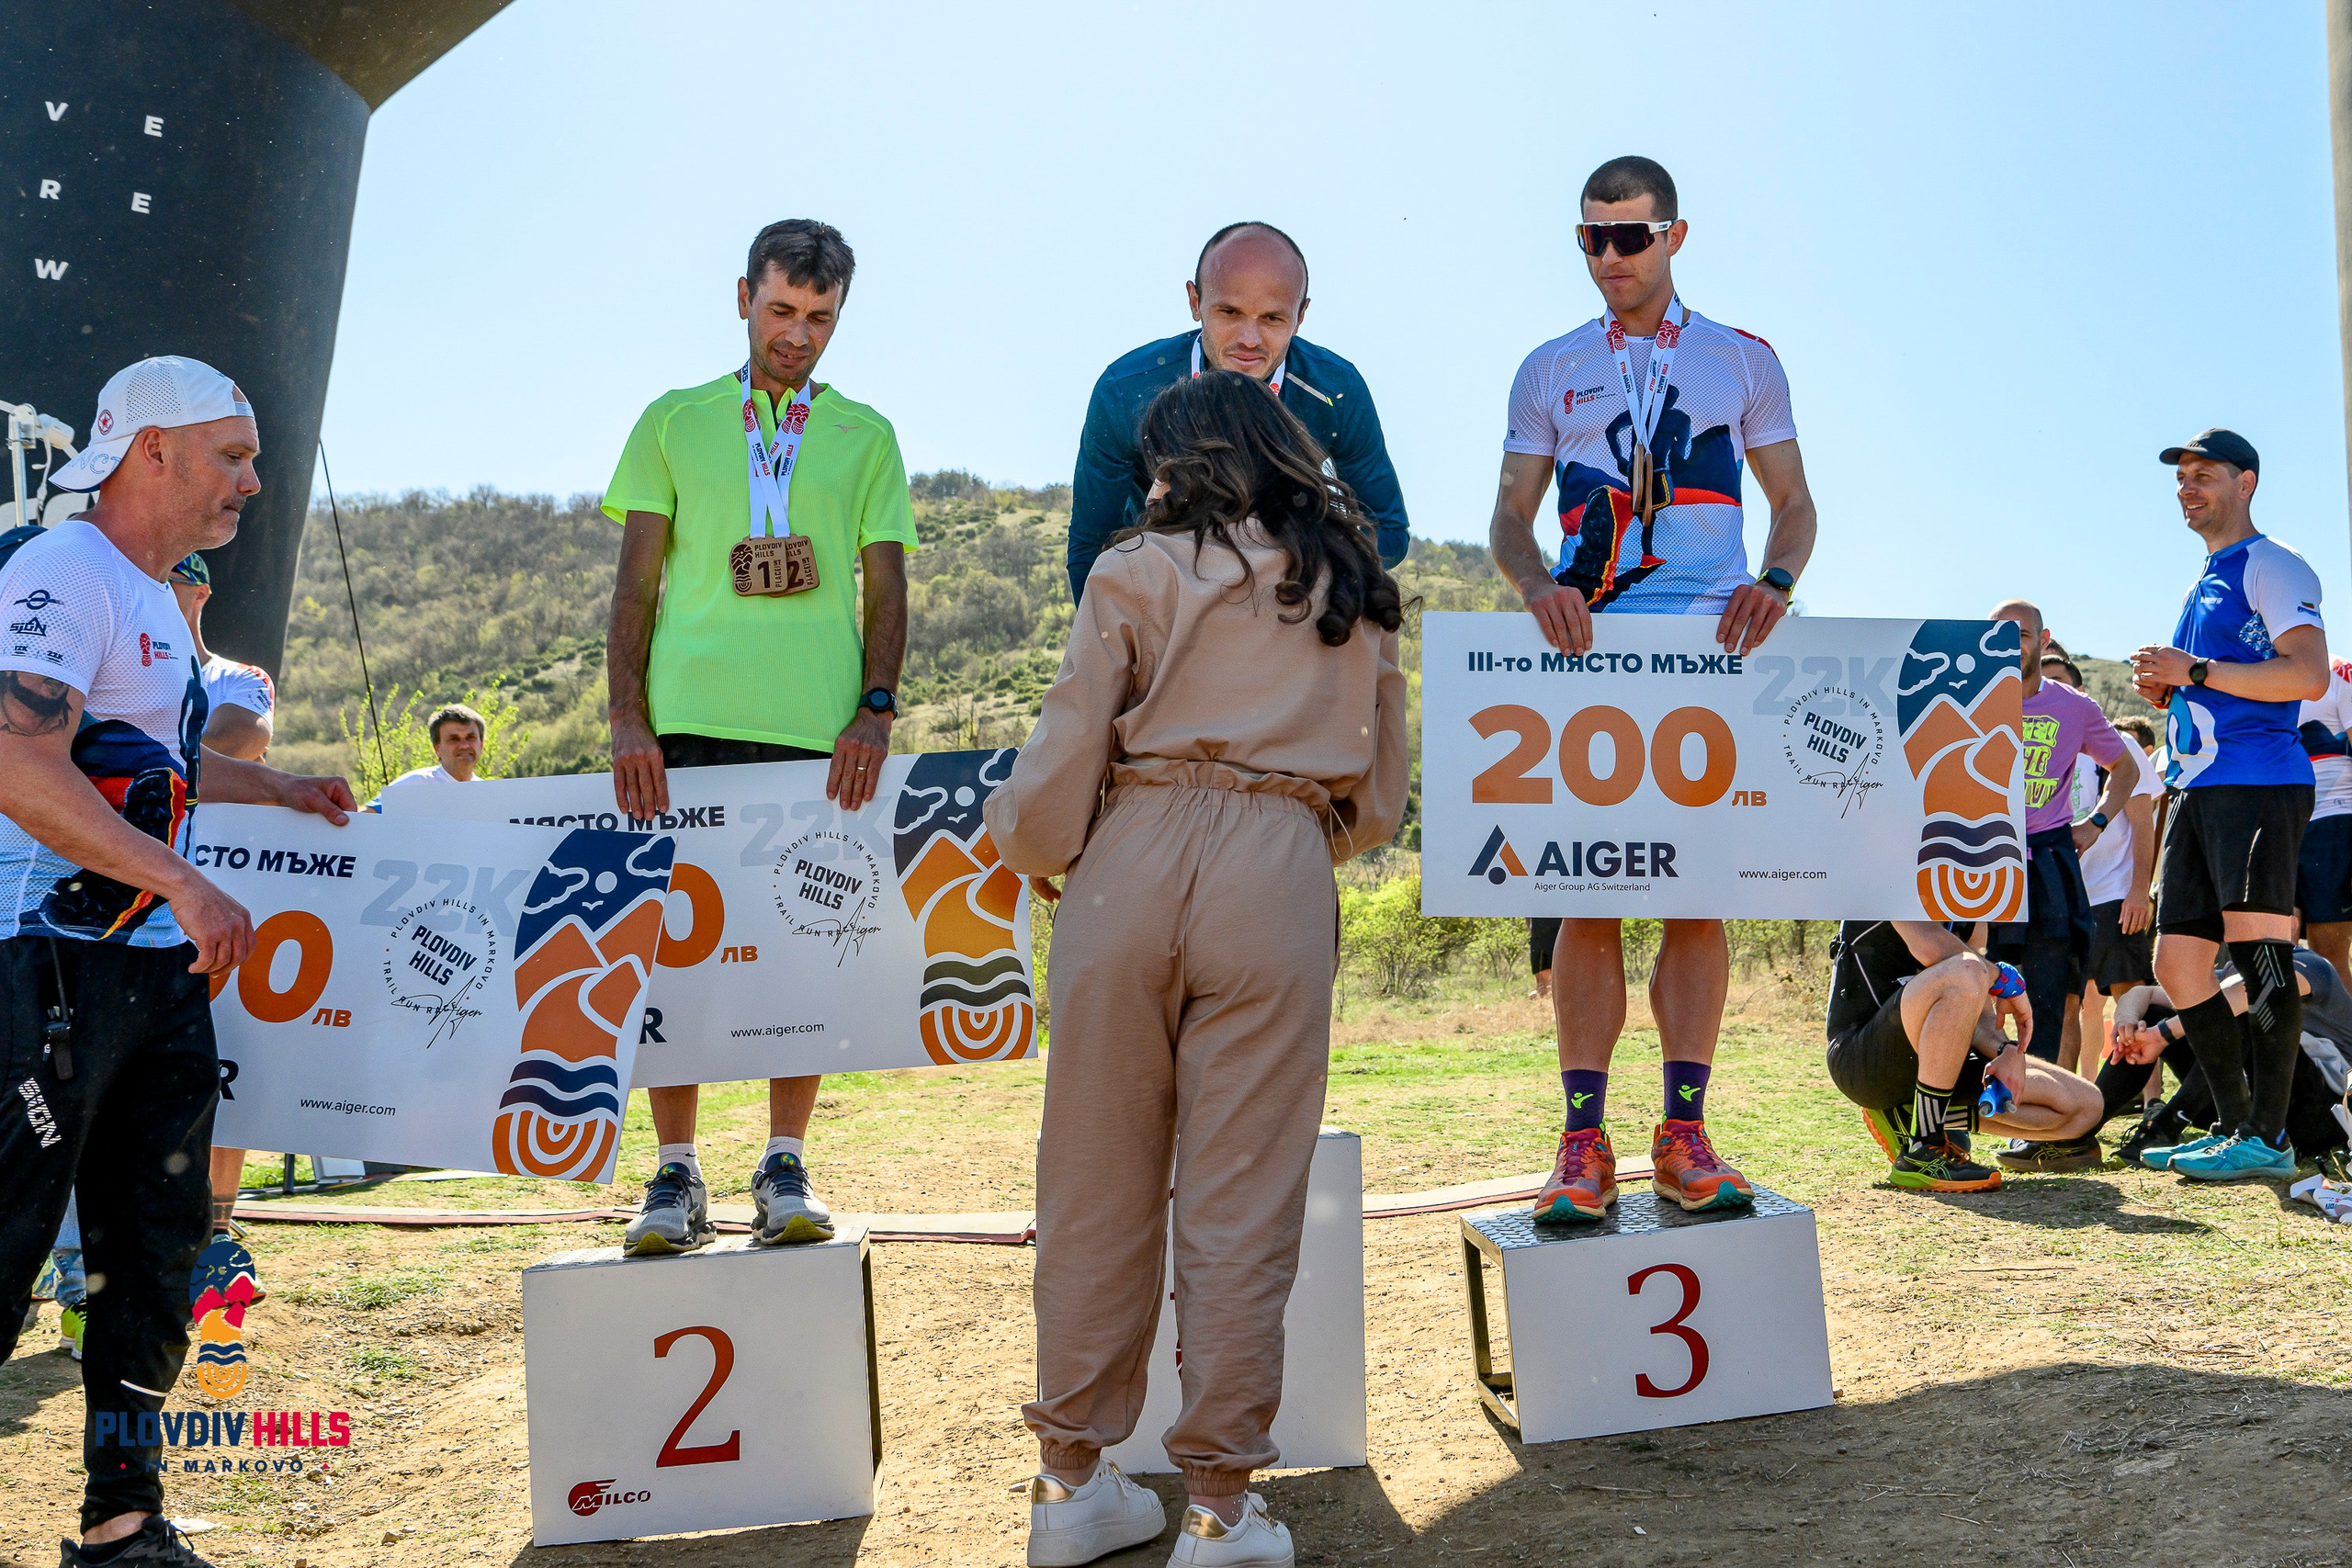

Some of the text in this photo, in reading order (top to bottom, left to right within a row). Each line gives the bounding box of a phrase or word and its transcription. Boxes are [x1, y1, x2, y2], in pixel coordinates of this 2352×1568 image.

[34, 258, 69, 280] W
[1576, 385, 1605, 399] PLOVDIV
[1576, 394, 1595, 405] HILLS
[754, 542, 783, 551] PLOVDIV
[786, 539, 808, 550] LOVDIV
[787, 549, 802, 558] ILLS
[757, 560, 771, 589] 1
[1541, 652, 1643, 673] МЯСТО
[1651, 653, 1743, 674] МЪЖЕ
[1752, 655, 1898, 716] 22K
[1784, 686, 1883, 765] PLOVDIV HILLS IN MARKOVO
[1803, 711, 1868, 750] PLOVDIV
[1468, 704, 1736, 807] 200
[1783, 744, 1802, 774] TRAIL
[1805, 774, 1826, 788] RUN
[1806, 733, 1849, 763] HILLS
[739, 795, 894, 867] 22K
[256, 849, 356, 878] МЪЖЕ
[774, 831, 880, 908] PLOVDIV HILLS IN MARKOVO
[795, 859, 864, 895] PLOVDIV
[1534, 840, 1680, 878] AIGER
[1738, 868, 1827, 880] www.aiger.com
[359, 859, 532, 938] 22K
[798, 882, 844, 910] HILLS
[1534, 882, 1651, 893] Aiger Group AG Switzerland
[774, 895, 795, 925] TRAIL
[798, 924, 821, 937] RUN
[390, 898, 496, 990] PLOVDIV HILLS IN MARKOVO
[411, 924, 478, 972] PLOVDIV
[383, 960, 398, 995] TRAIL
[398, 995, 420, 1011] RUN
[409, 950, 455, 987] HILLS
[730, 1022, 825, 1038] www.aiger.com
[300, 1099, 396, 1116] www.aiger.com
[1626, 1262, 1710, 1399] 3
[653, 1325, 741, 1469] 2
[571, 1490, 651, 1511] MILCO
